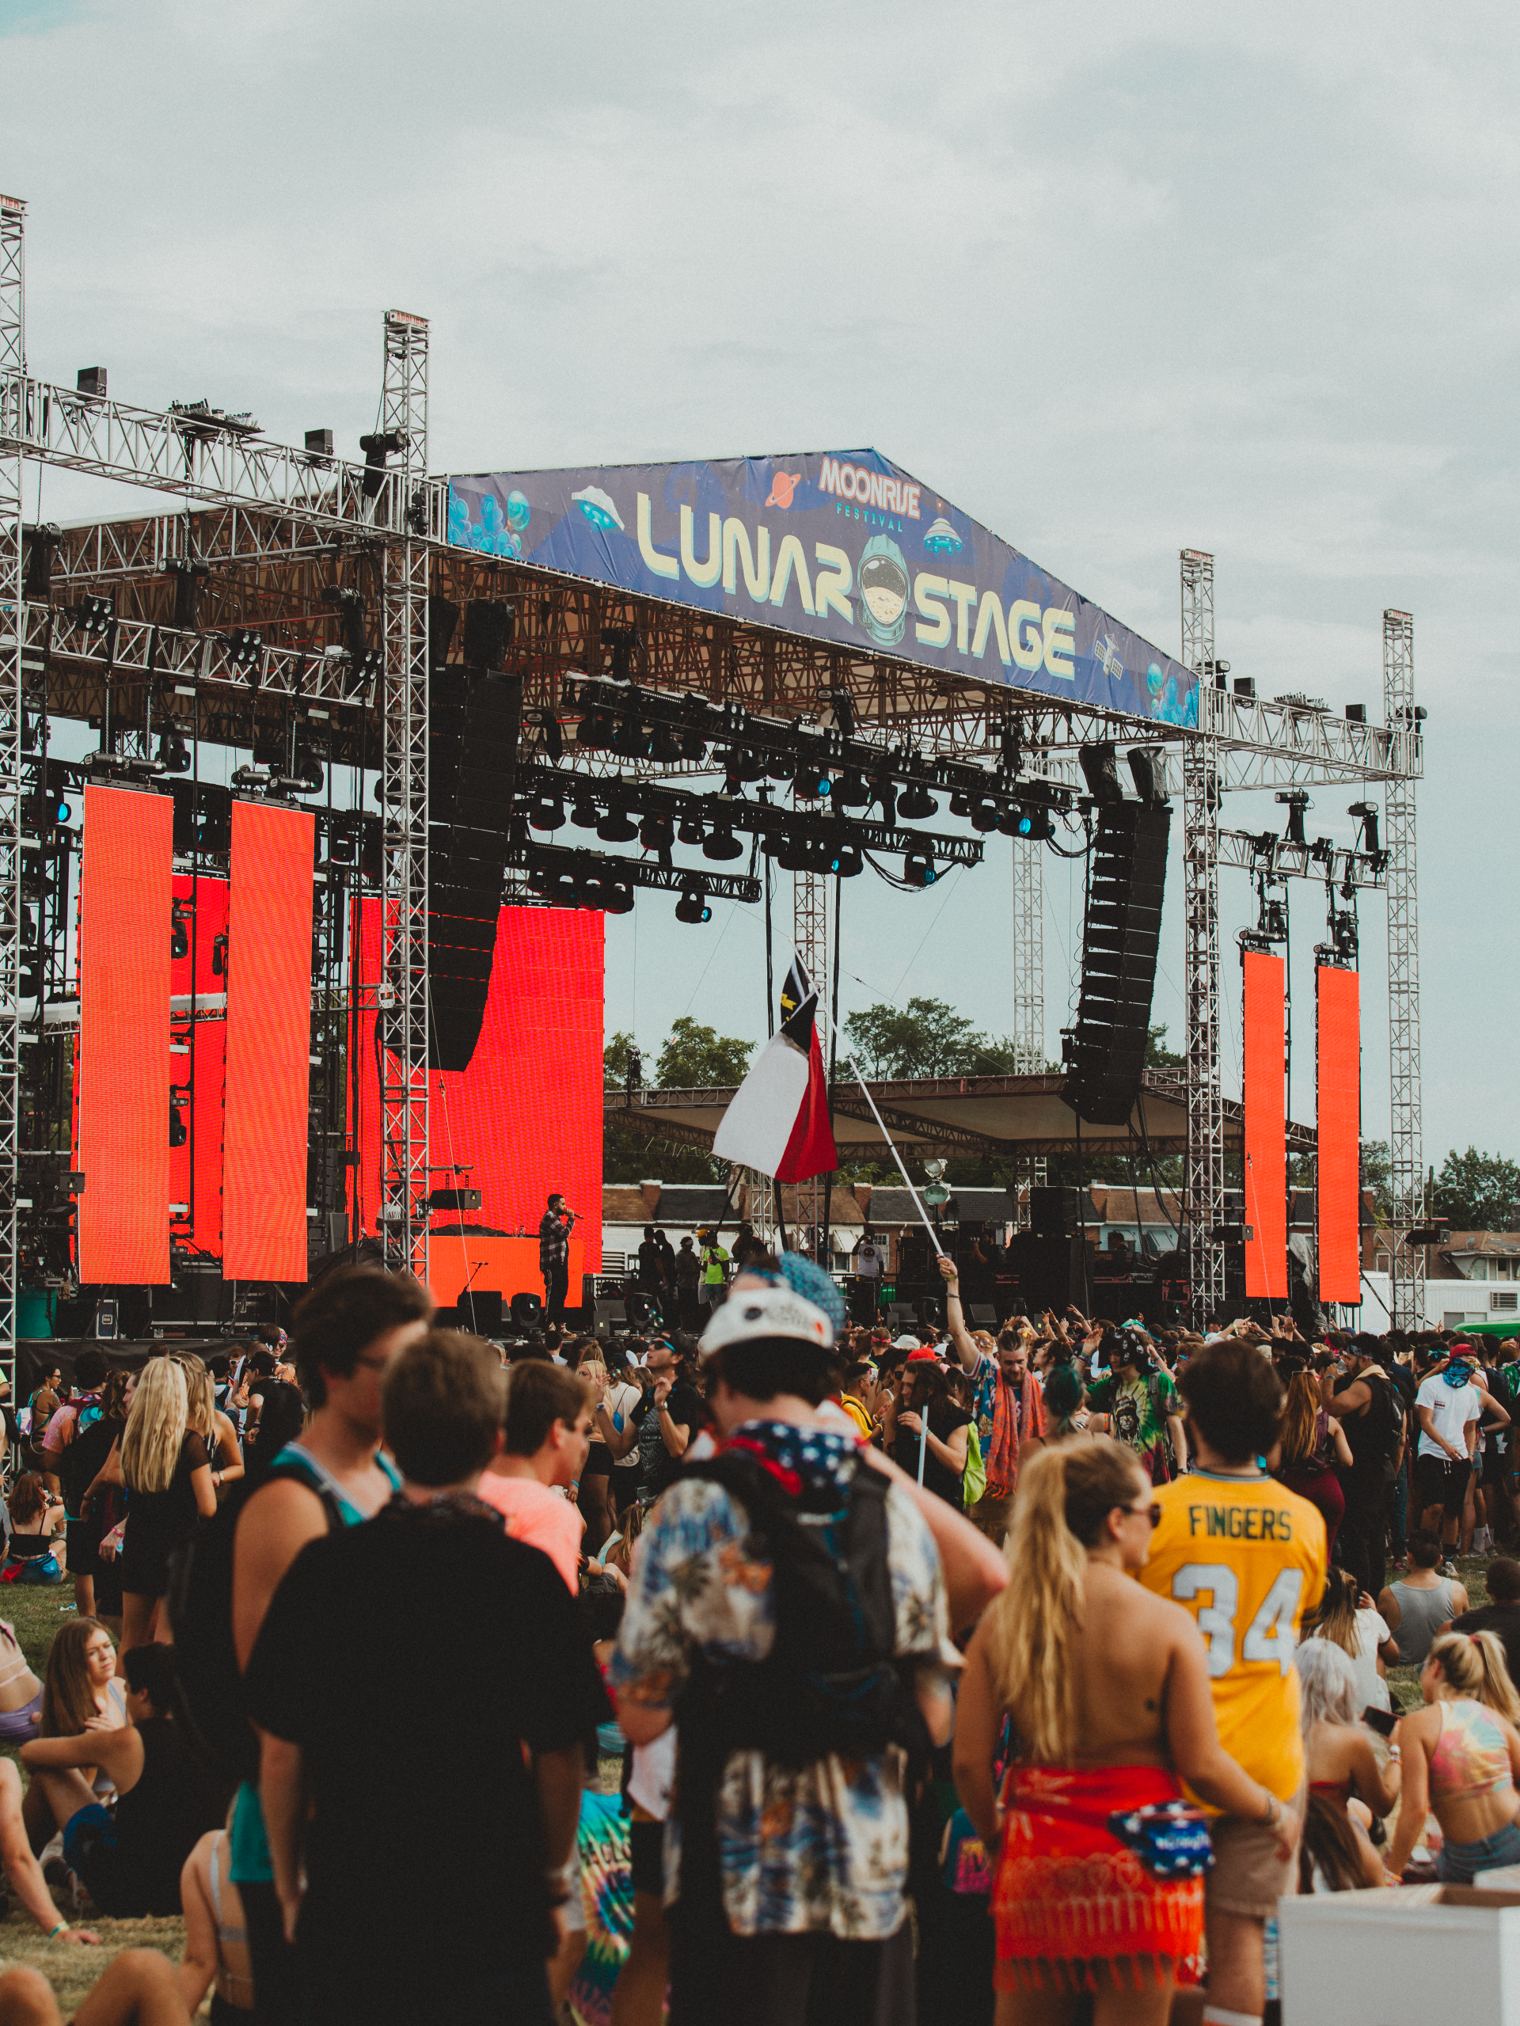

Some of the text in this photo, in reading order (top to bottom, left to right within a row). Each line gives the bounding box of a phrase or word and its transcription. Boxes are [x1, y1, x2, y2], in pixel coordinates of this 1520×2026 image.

[835, 501, 903, 532] FESTIVAL
[636, 491, 1076, 681] LUNAR STAGE
[1188, 1506, 1293, 1542] FINGERS
[1172, 1563, 1305, 1678] 34
